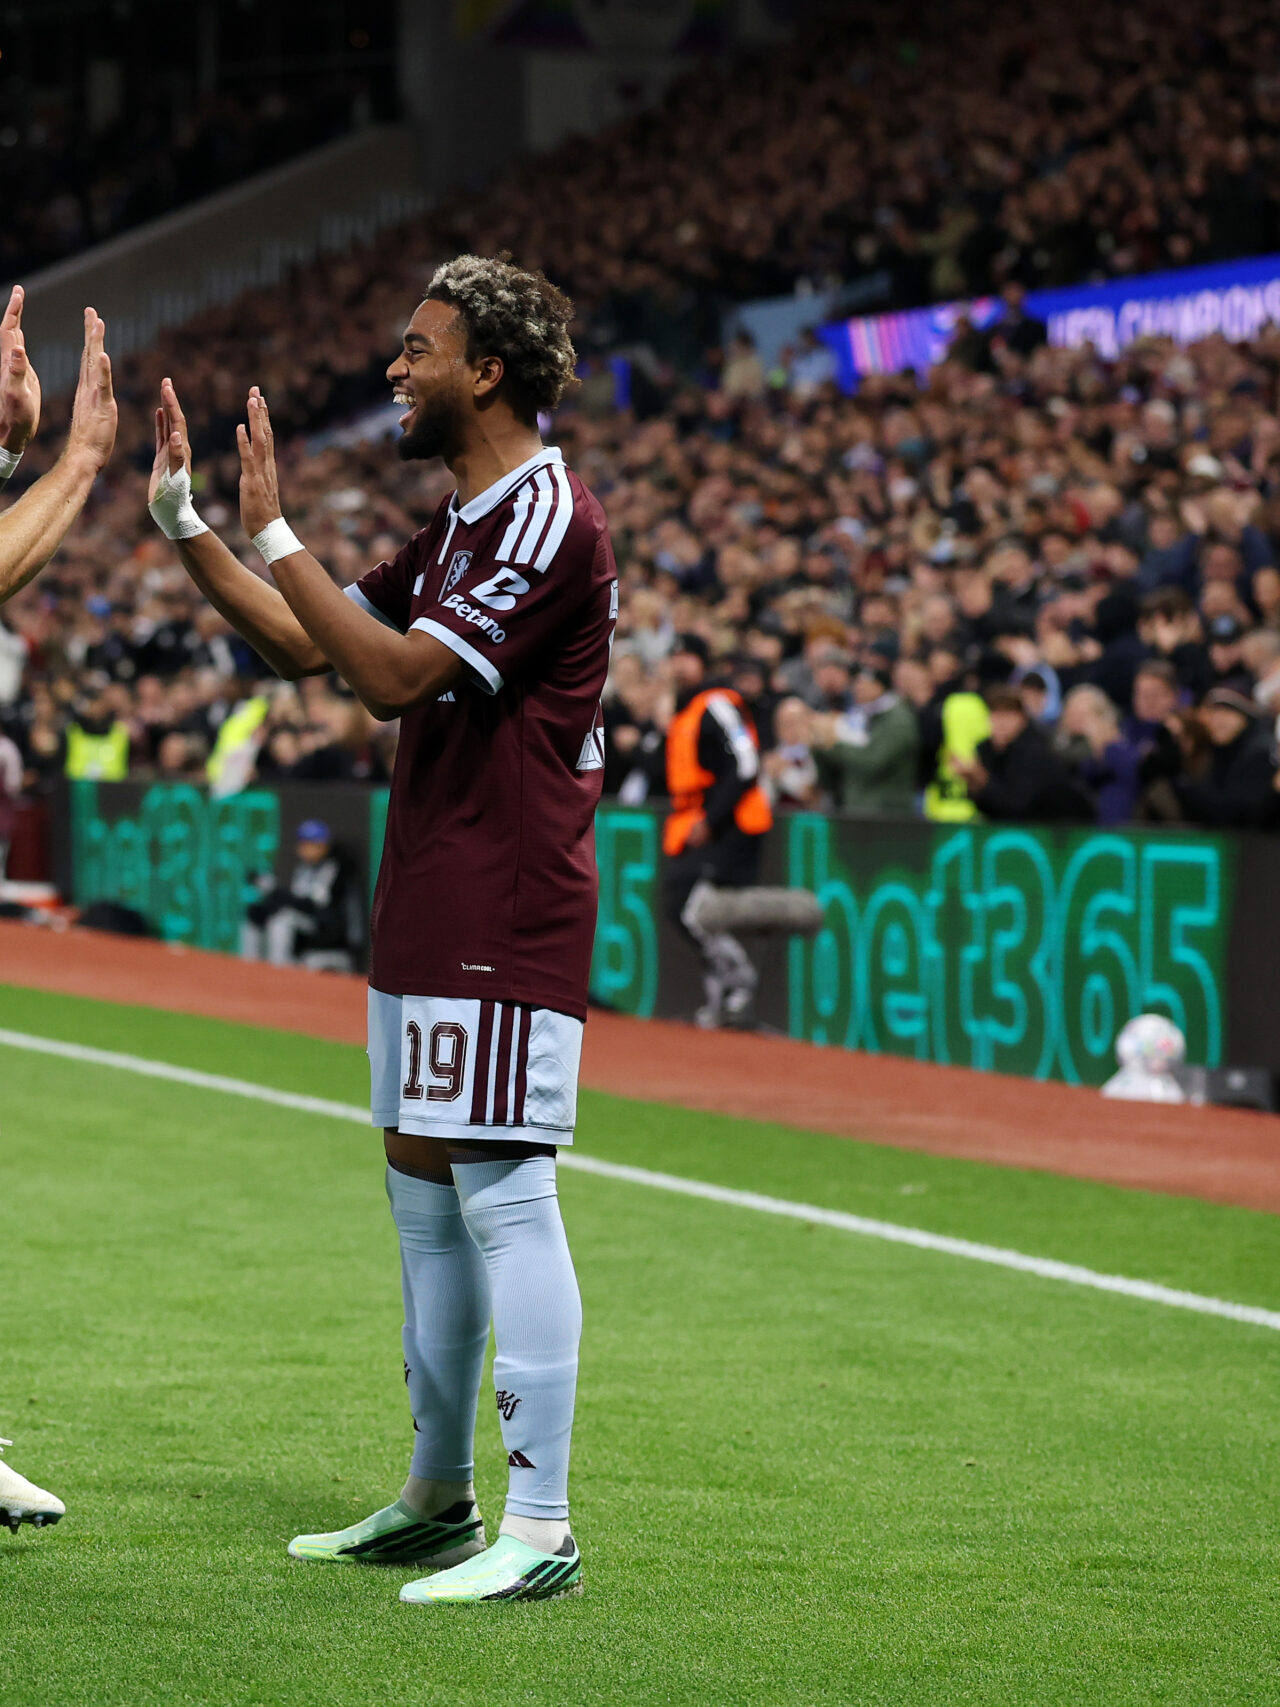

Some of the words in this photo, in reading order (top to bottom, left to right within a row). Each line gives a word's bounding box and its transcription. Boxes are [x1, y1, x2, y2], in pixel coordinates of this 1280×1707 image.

[440, 593, 506, 644] Betano
[788, 811, 1221, 1087] bet365
[402, 1019, 468, 1103] 19
